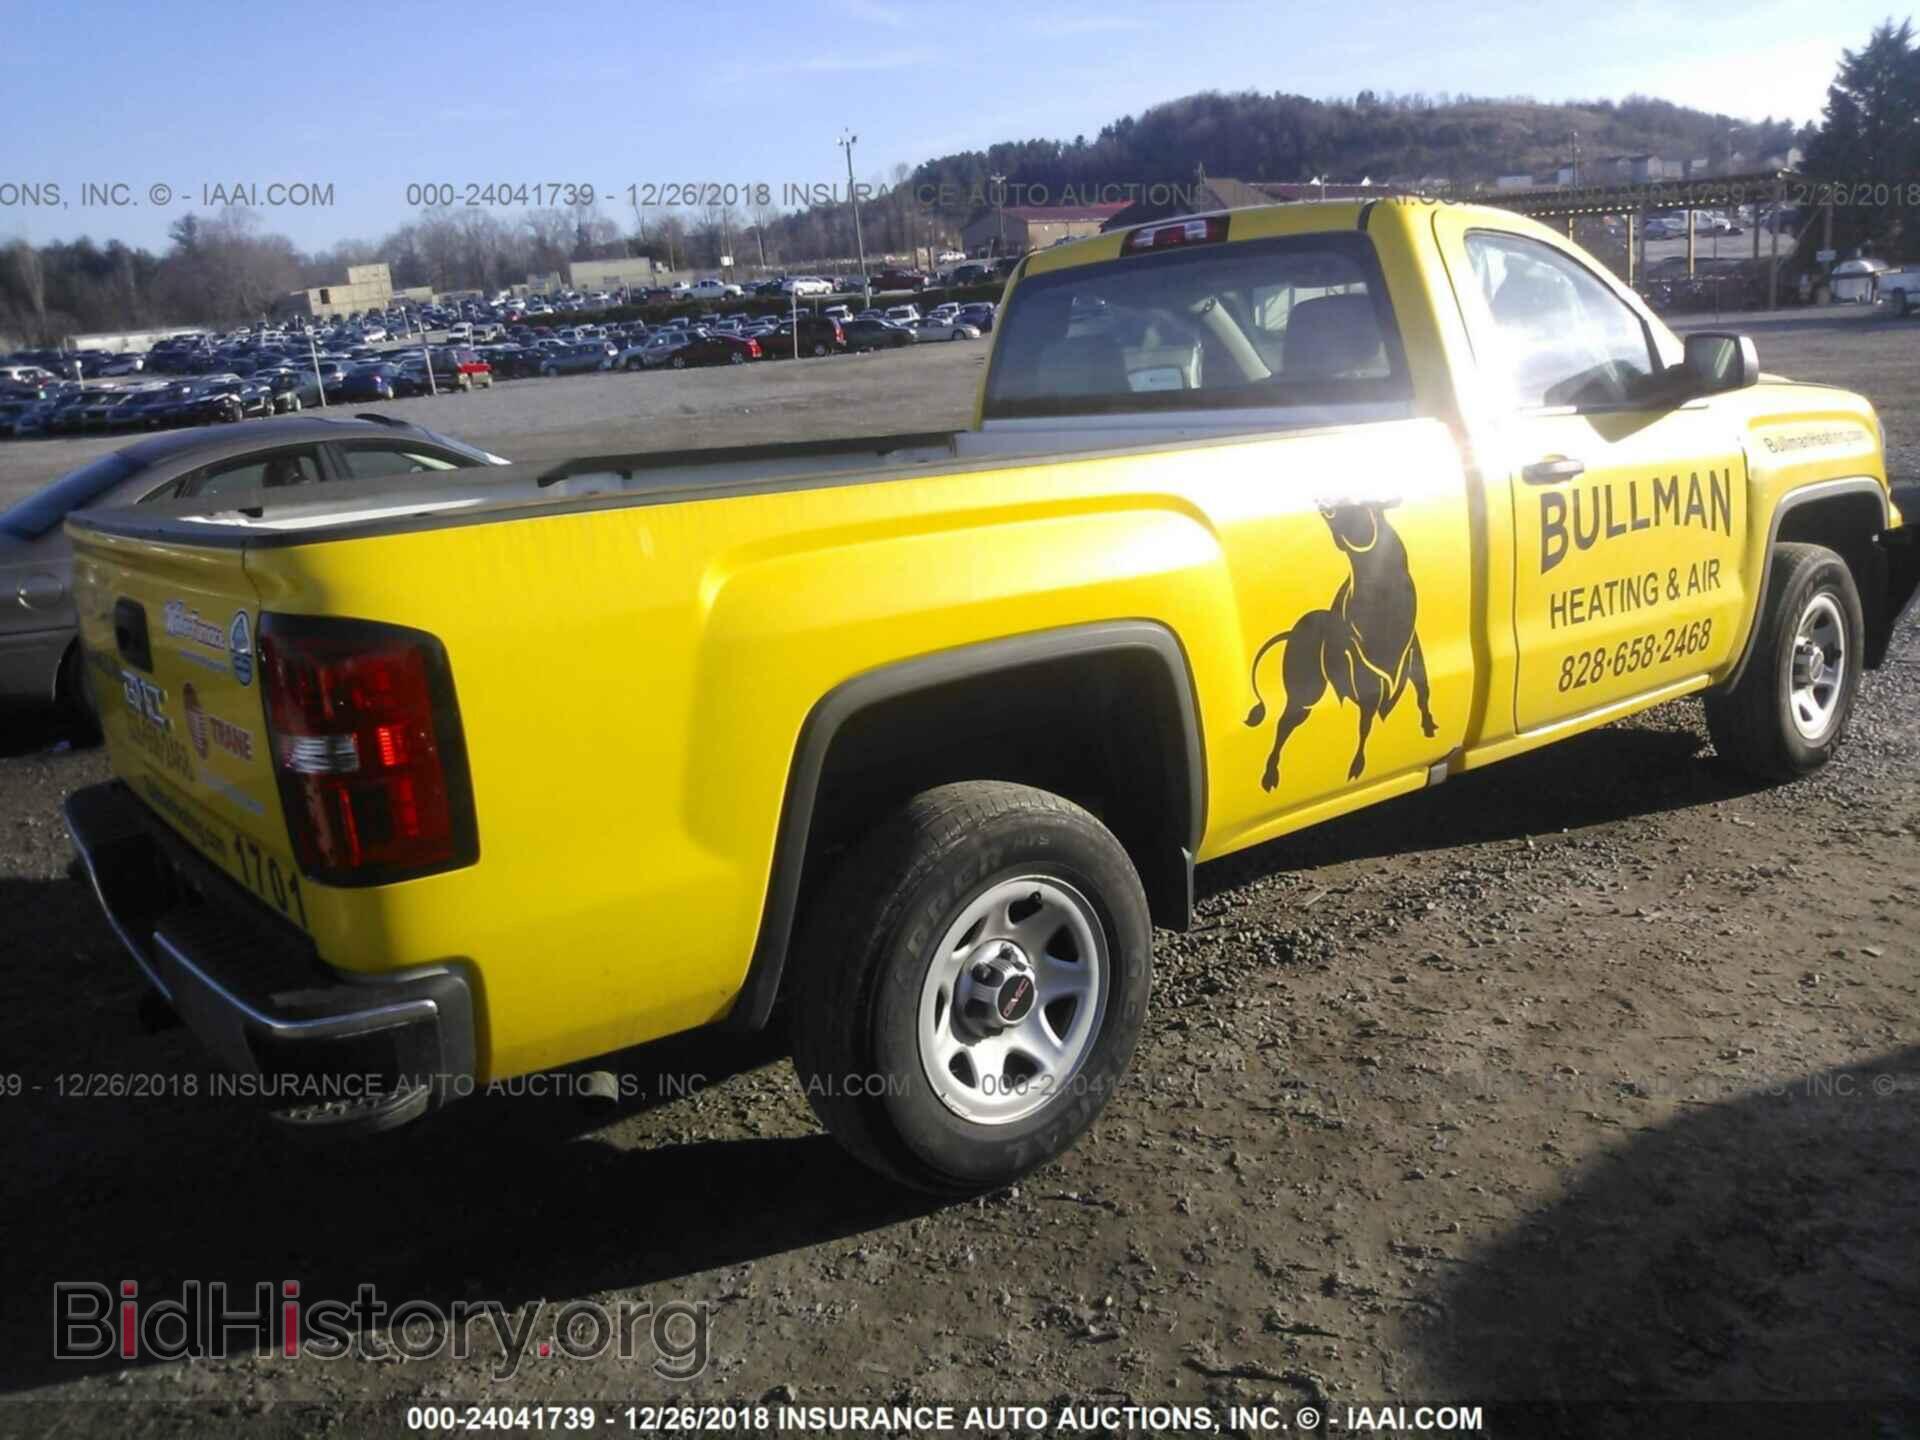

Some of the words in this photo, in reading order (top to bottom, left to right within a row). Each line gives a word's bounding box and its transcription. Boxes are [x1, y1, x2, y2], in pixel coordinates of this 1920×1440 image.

[1540, 468, 1731, 575] BULLMAN
[1550, 571, 1659, 629] HEATING
[1666, 567, 1680, 601] &
[1687, 558, 1721, 595] AIR
